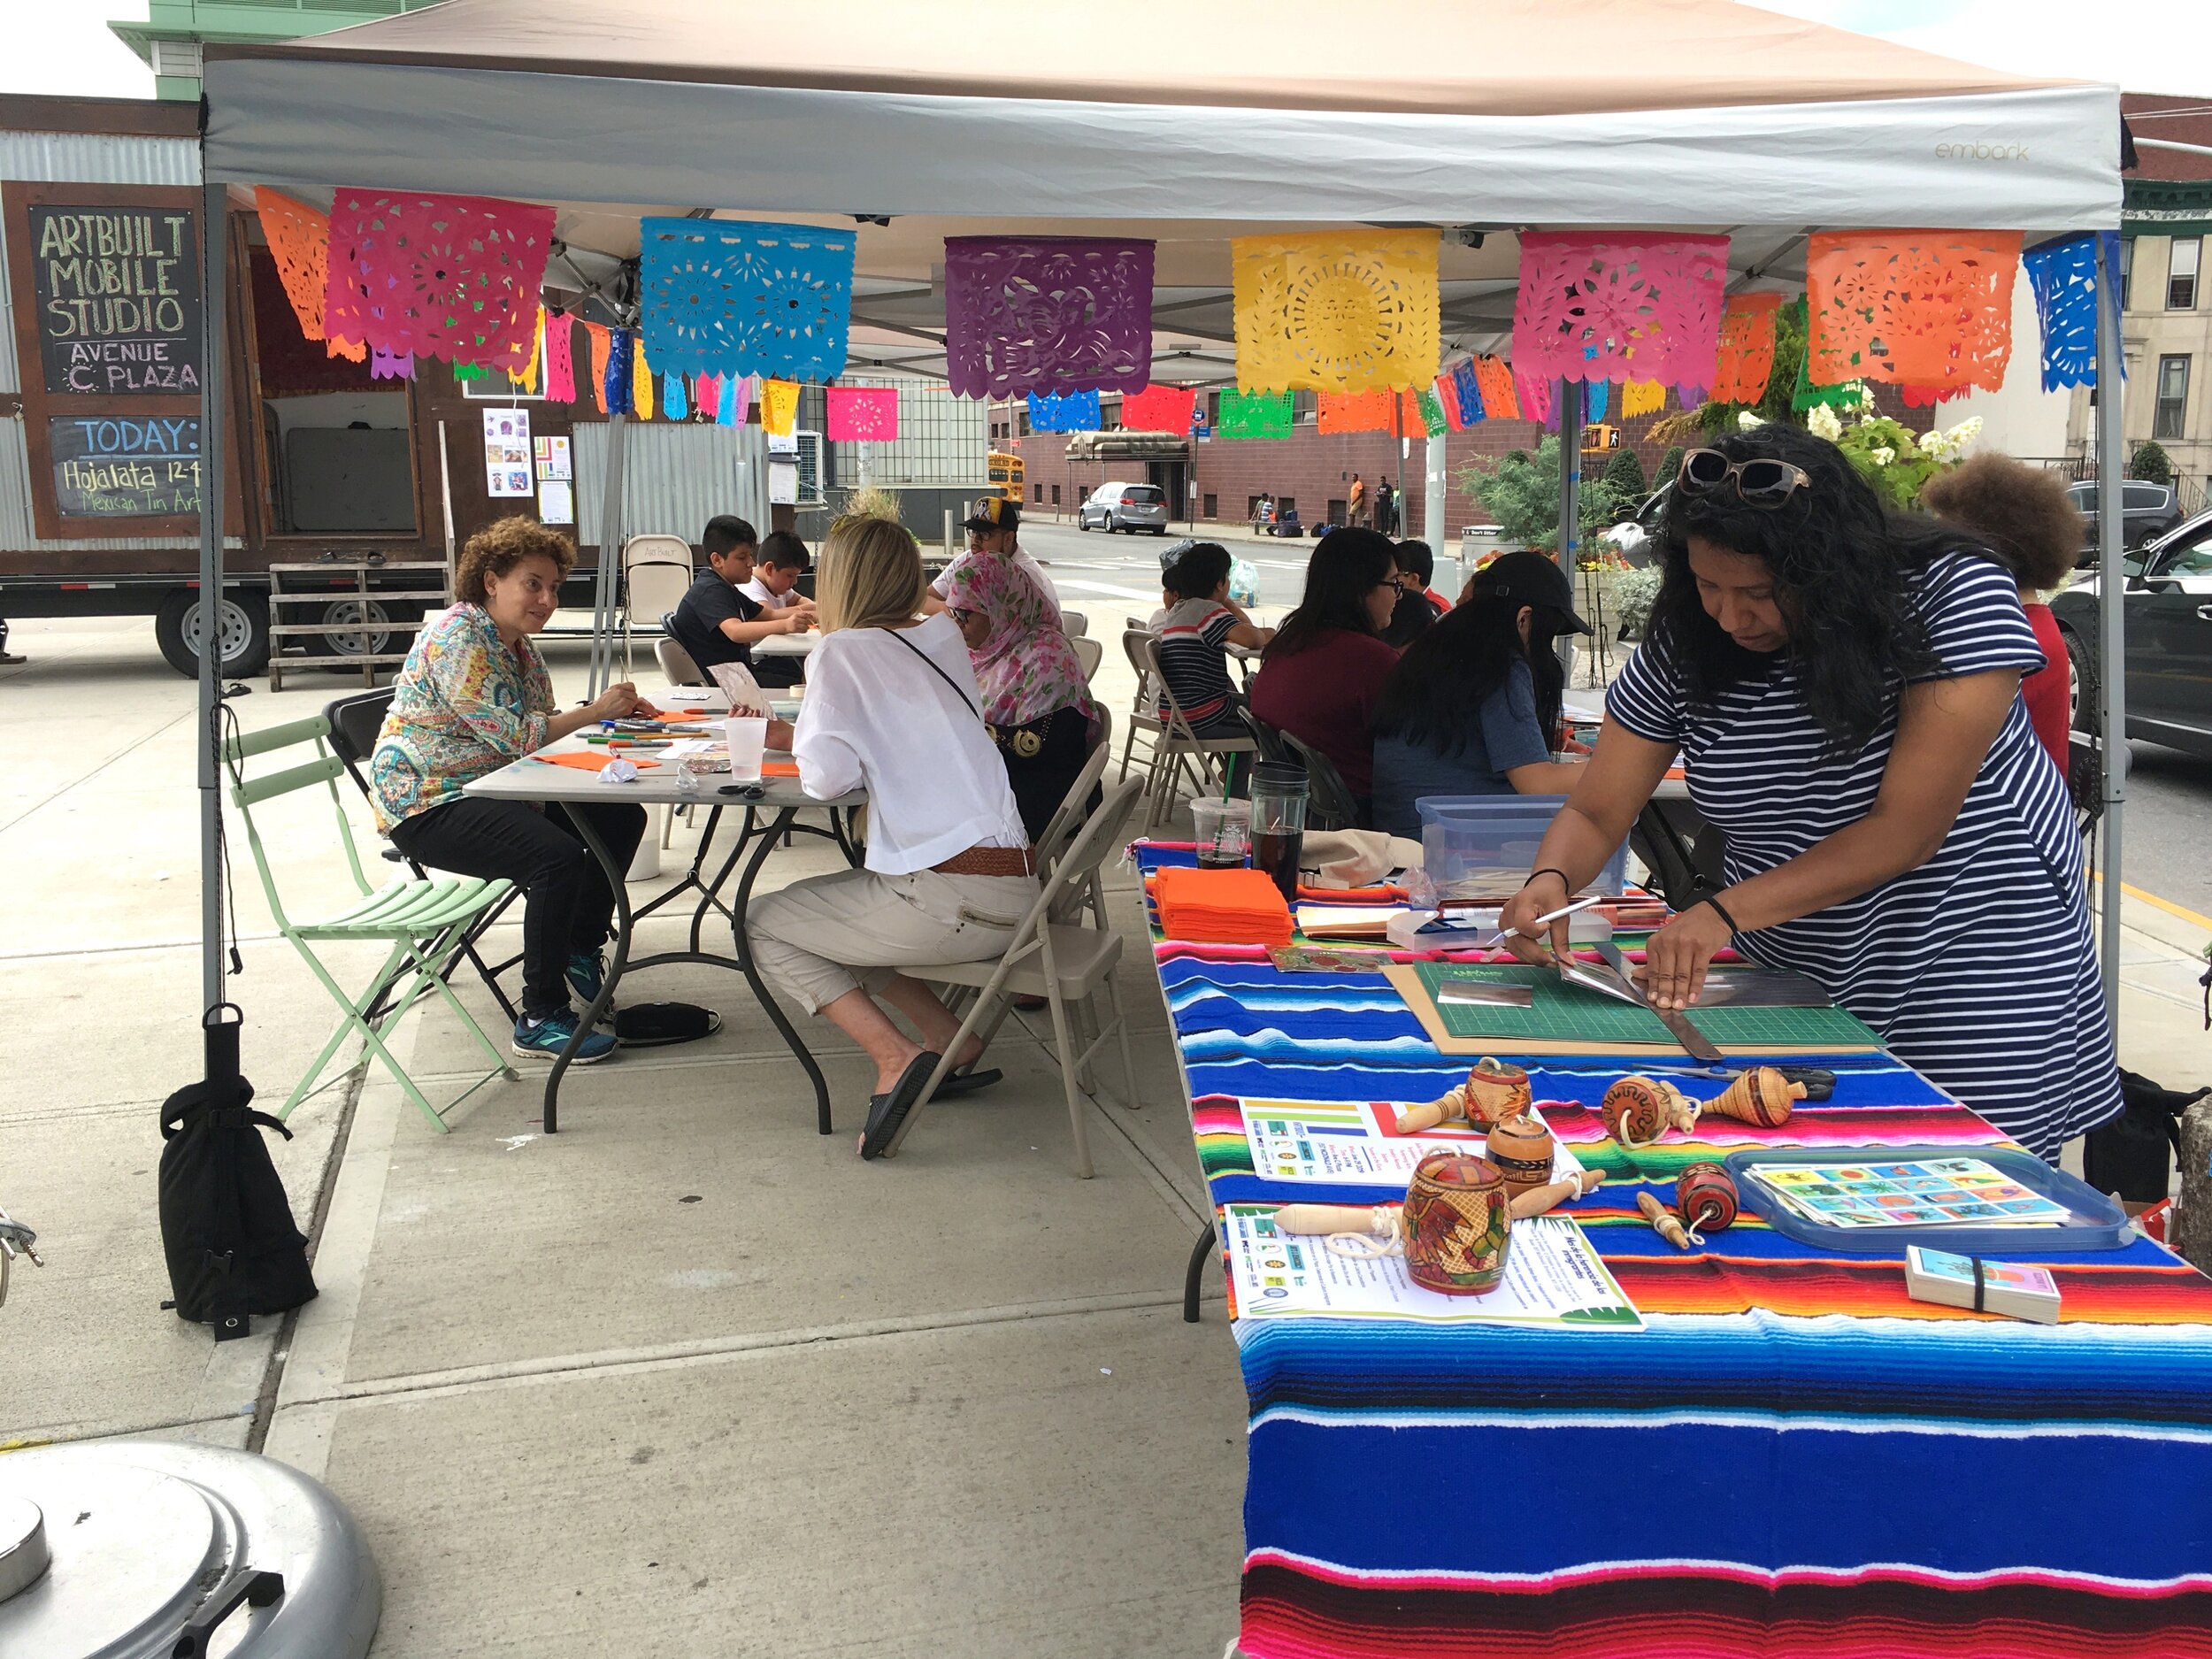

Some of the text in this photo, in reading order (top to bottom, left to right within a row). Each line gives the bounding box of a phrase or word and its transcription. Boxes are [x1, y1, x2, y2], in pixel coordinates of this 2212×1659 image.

[1935, 141, 2029, 162] embark
[40, 215, 185, 257] ARTBUILT
[50, 259, 179, 297] MOBILE
[47, 297, 184, 336] STUDIO
[71, 343, 169, 363] AVENUE
[69, 364, 199, 392] C PLAZA
[74, 420, 199, 452] TODAY:
[63, 461, 202, 492] Hojalata 12-4
[82, 488, 201, 512] Mexican Tin Art
